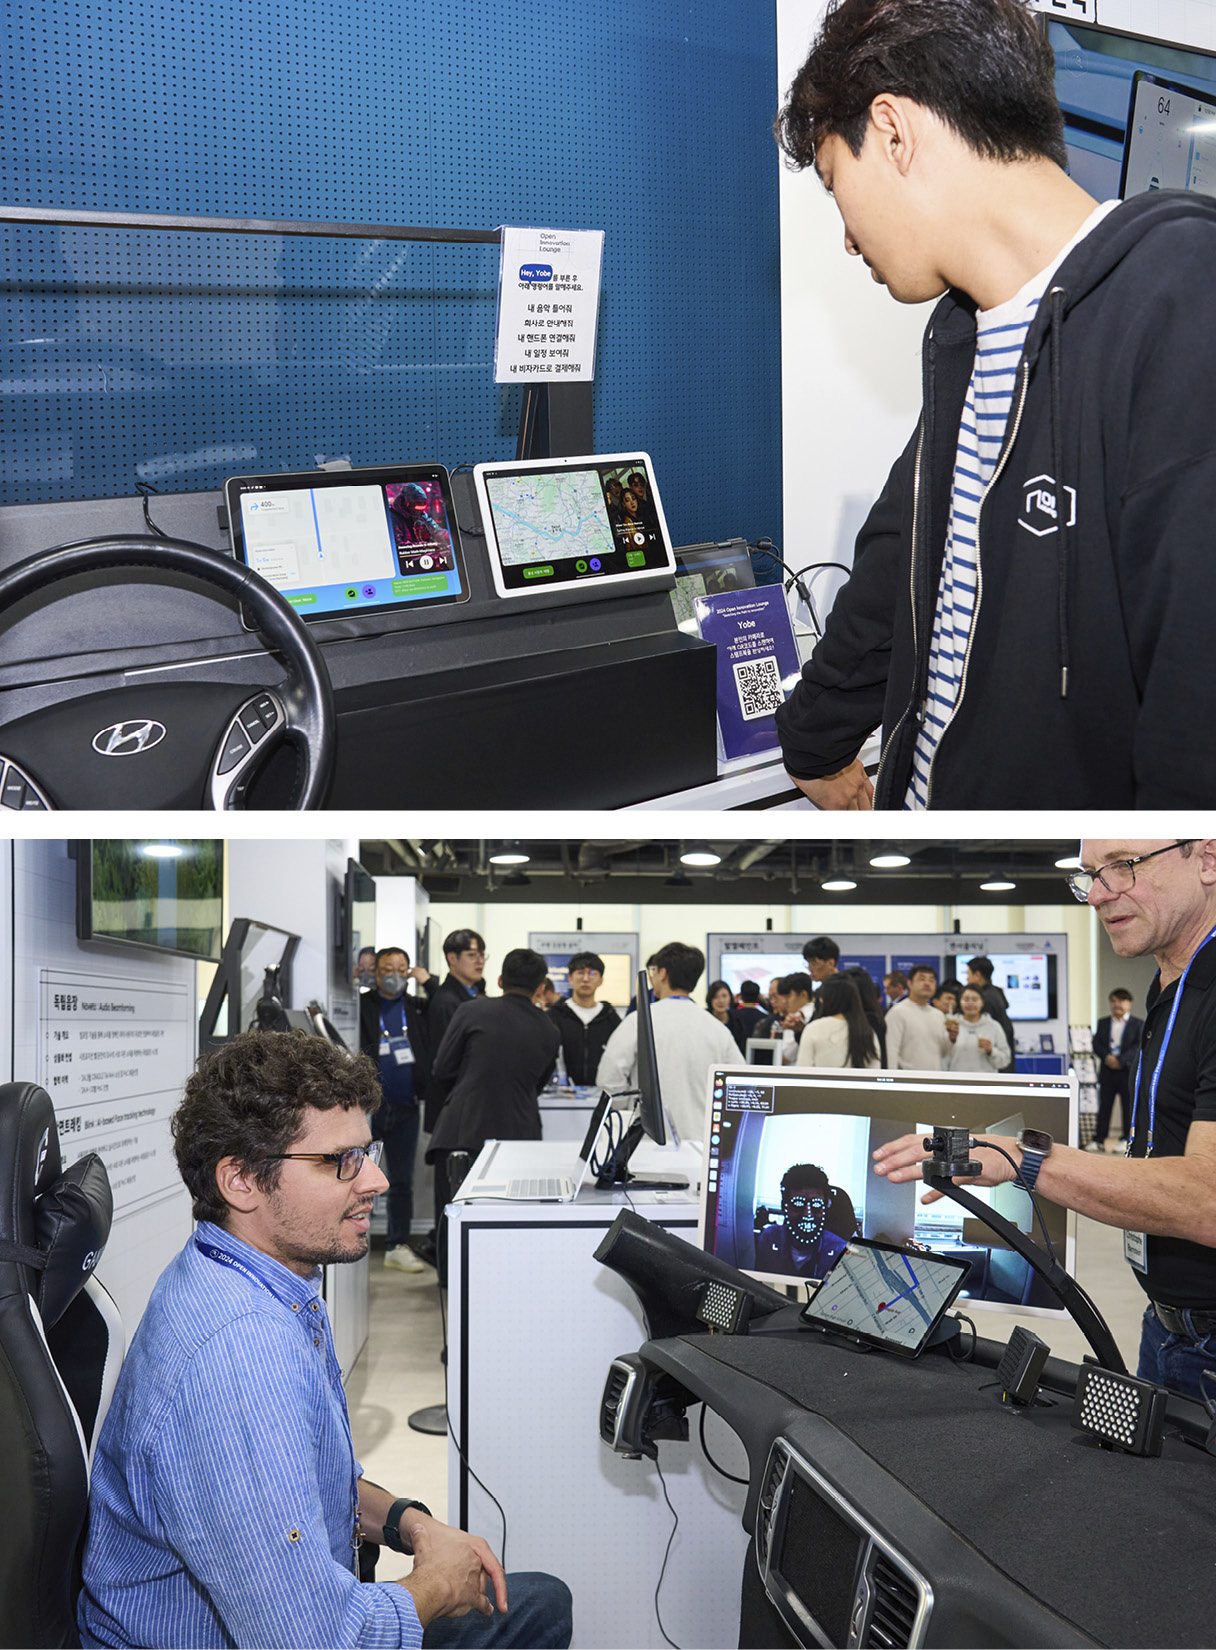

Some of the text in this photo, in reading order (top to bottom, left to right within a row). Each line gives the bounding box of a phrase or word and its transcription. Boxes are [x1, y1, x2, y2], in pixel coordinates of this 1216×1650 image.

[1157, 96, 1171, 116] 64
[520, 269, 552, 278] Hey, Yobe
[527, 303, 573, 313] 내 음악 틀어줘
[523, 319, 574, 328] 회사로 안내해줘
[517, 333, 576, 343] 내 핸드폰 연결해줘
[524, 349, 569, 359] 내 일정 보여줘
[510, 363, 582, 373] 내 비자카드로 결제해줘
[737, 619, 756, 630] Yobe
[54, 994, 78, 1011] 독립음장
[218, 1253, 233, 1264] 2024
[233, 1262, 247, 1273] OPEN
[246, 1270, 275, 1298] INNOVATION
